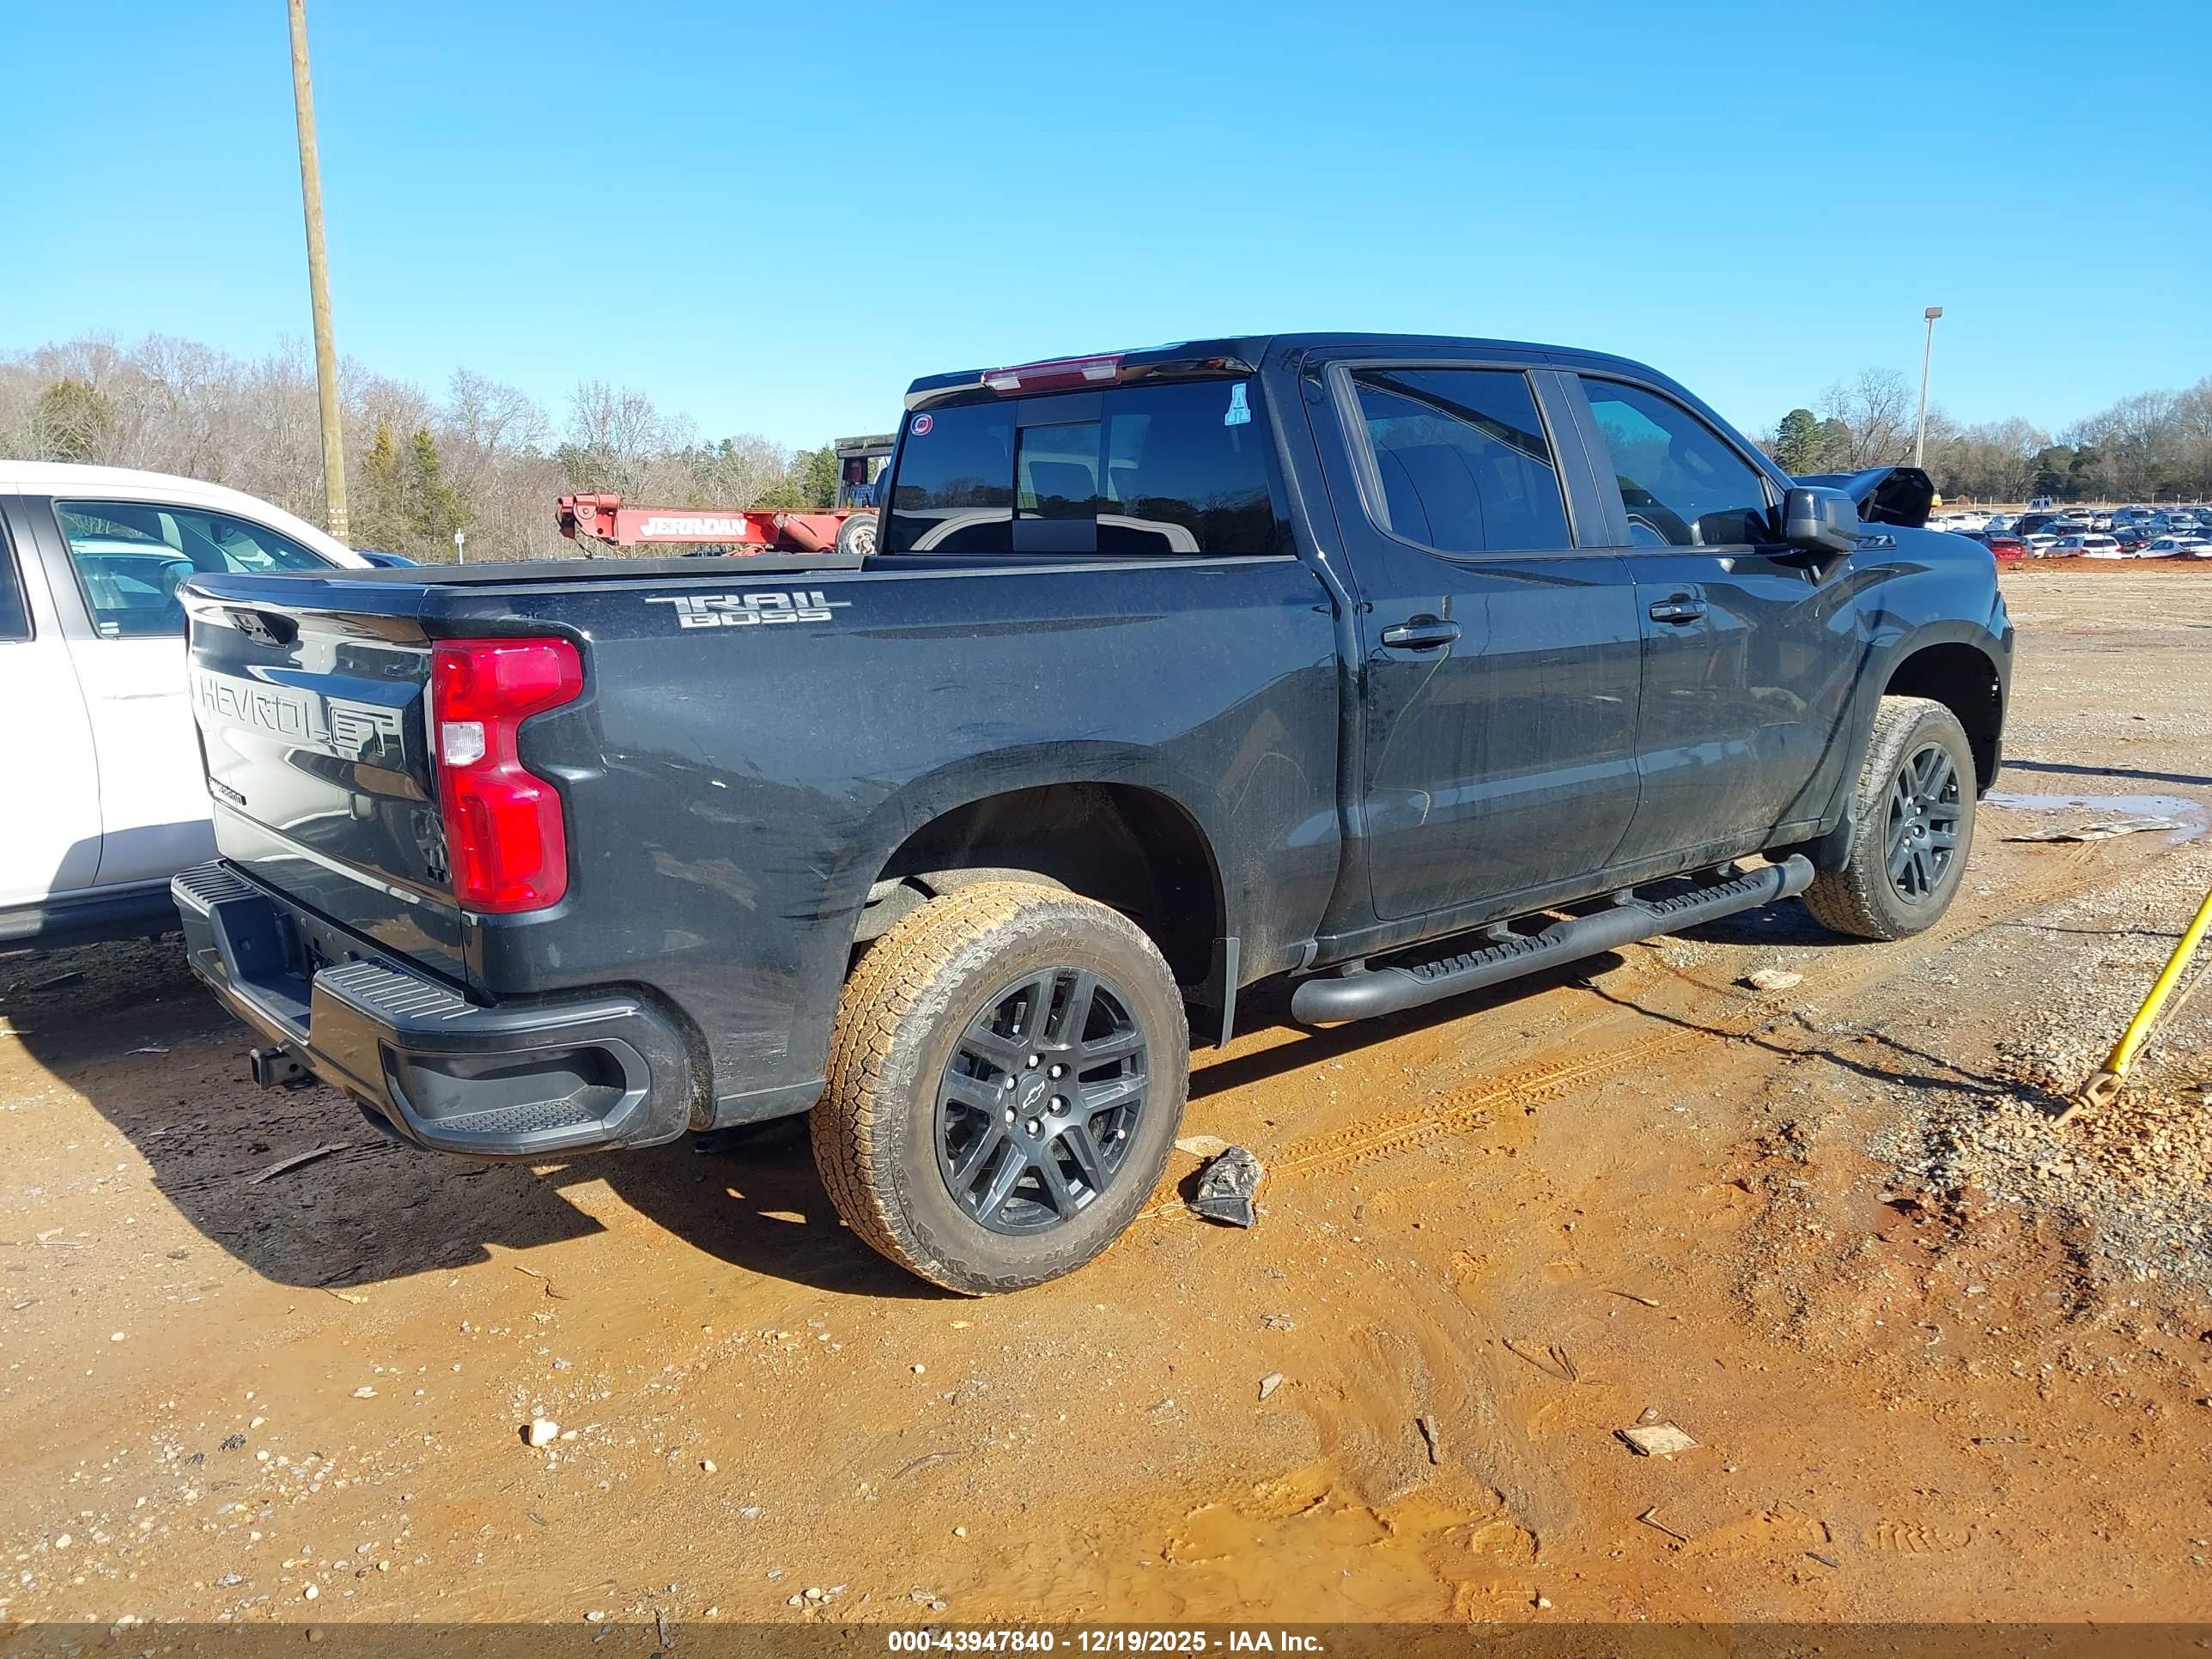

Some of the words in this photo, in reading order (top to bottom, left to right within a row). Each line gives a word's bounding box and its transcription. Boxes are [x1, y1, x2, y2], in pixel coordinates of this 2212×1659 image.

[2033, 500, 2040, 508] M
[2044, 499, 2051, 507] N
[645, 591, 853, 614] TRAIL
[680, 606, 833, 629] BOSS
